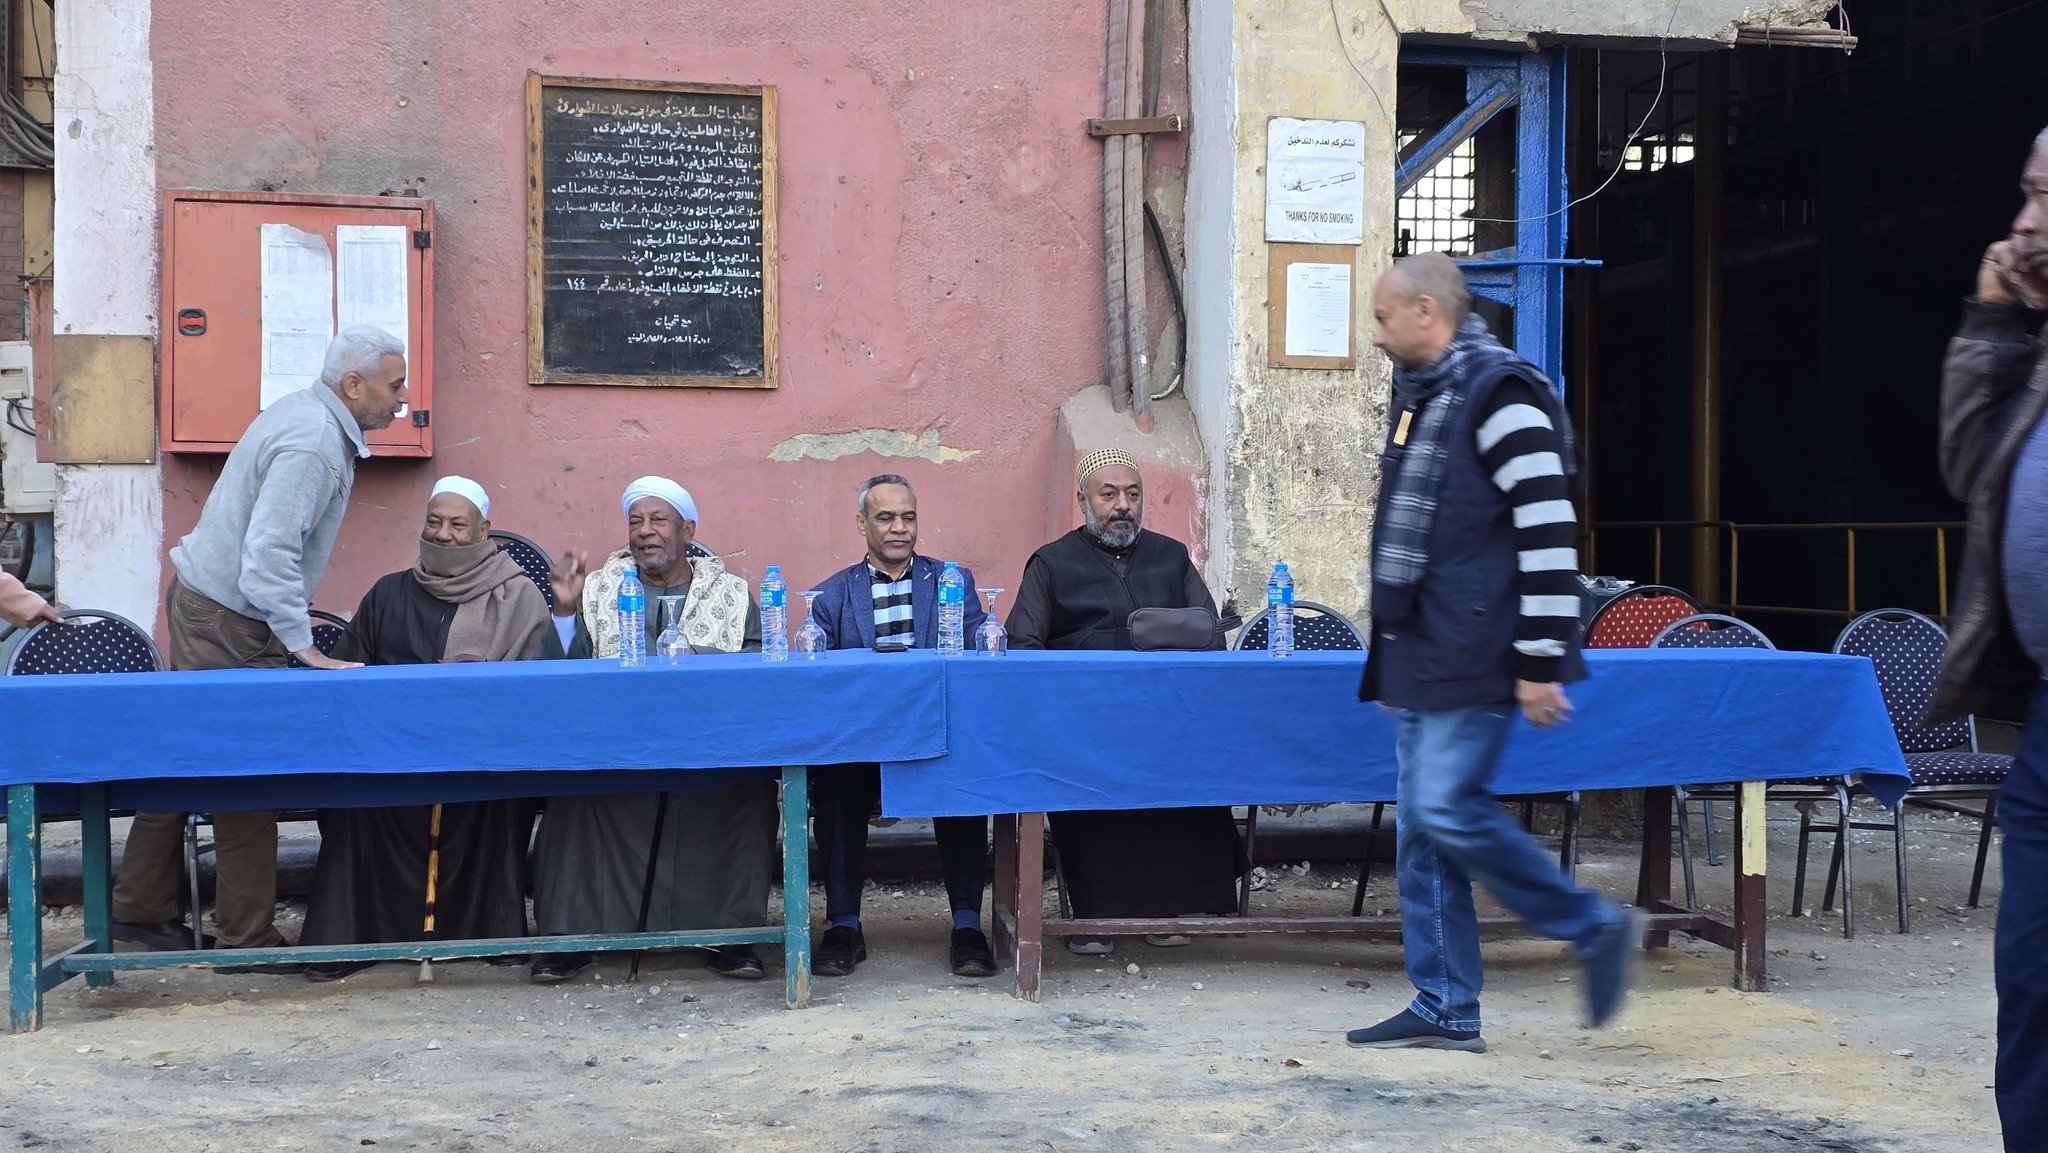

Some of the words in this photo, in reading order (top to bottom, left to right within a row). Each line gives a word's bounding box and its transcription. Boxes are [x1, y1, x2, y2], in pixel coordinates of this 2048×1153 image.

[600, 103, 629, 116] حالات
[672, 105, 717, 118] السلامة
[639, 122, 671, 135] حالات
[682, 124, 721, 139] العاملين
[722, 126, 756, 140] واجبات
[1287, 136, 1314, 147] التدخين
[1315, 138, 1330, 146] لعدم
[1331, 139, 1355, 148] نشكركم
[1286, 211, 1307, 222] THANKS
[1308, 212, 1319, 222] FOR
[1320, 213, 1327, 223] NO
[1329, 213, 1354, 224] SMOKING
[677, 234, 698, 244] حالة
[712, 232, 750, 246] التصرف
[679, 269, 704, 279] جرس
[723, 267, 749, 277] الضغط
[704, 282, 723, 293] نقطة
[655, 314, 679, 330] تحيات
[681, 319, 692, 327] مع
